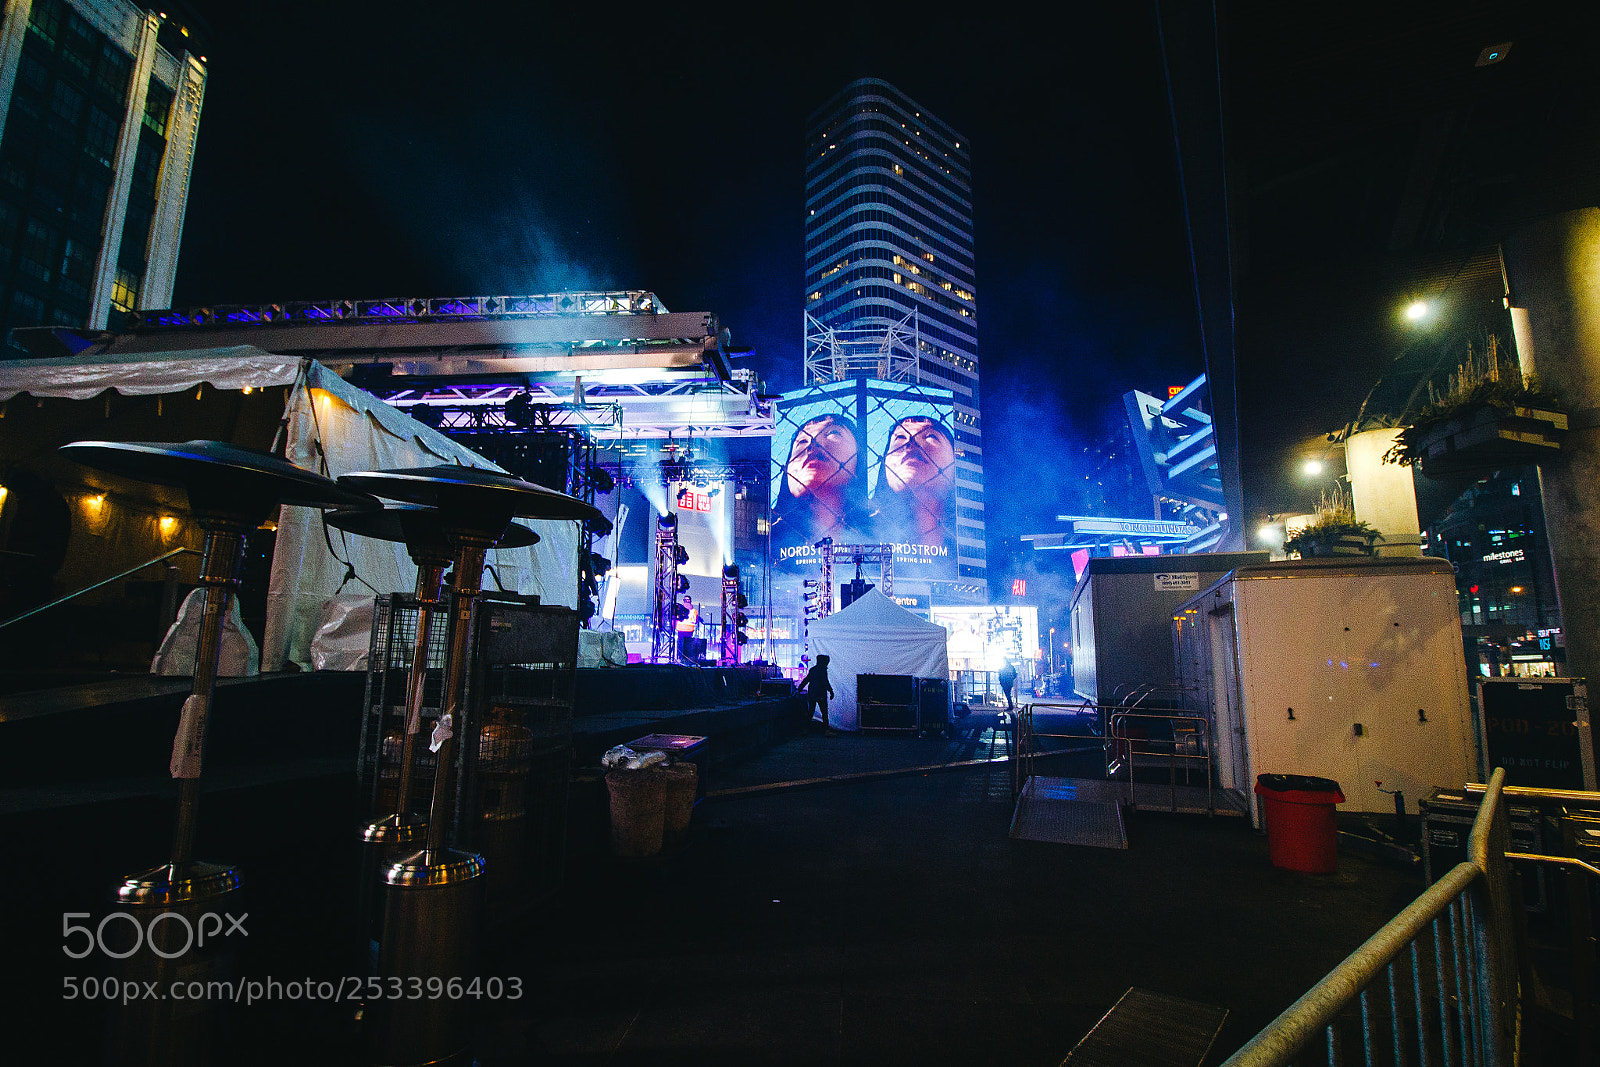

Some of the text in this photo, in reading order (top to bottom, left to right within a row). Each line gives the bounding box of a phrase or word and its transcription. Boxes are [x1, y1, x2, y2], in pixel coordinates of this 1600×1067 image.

[780, 543, 848, 558] NORDSTM
[1482, 549, 1524, 562] milestones
[1011, 579, 1027, 597] H&M
[1544, 759, 1570, 770] FLIP
